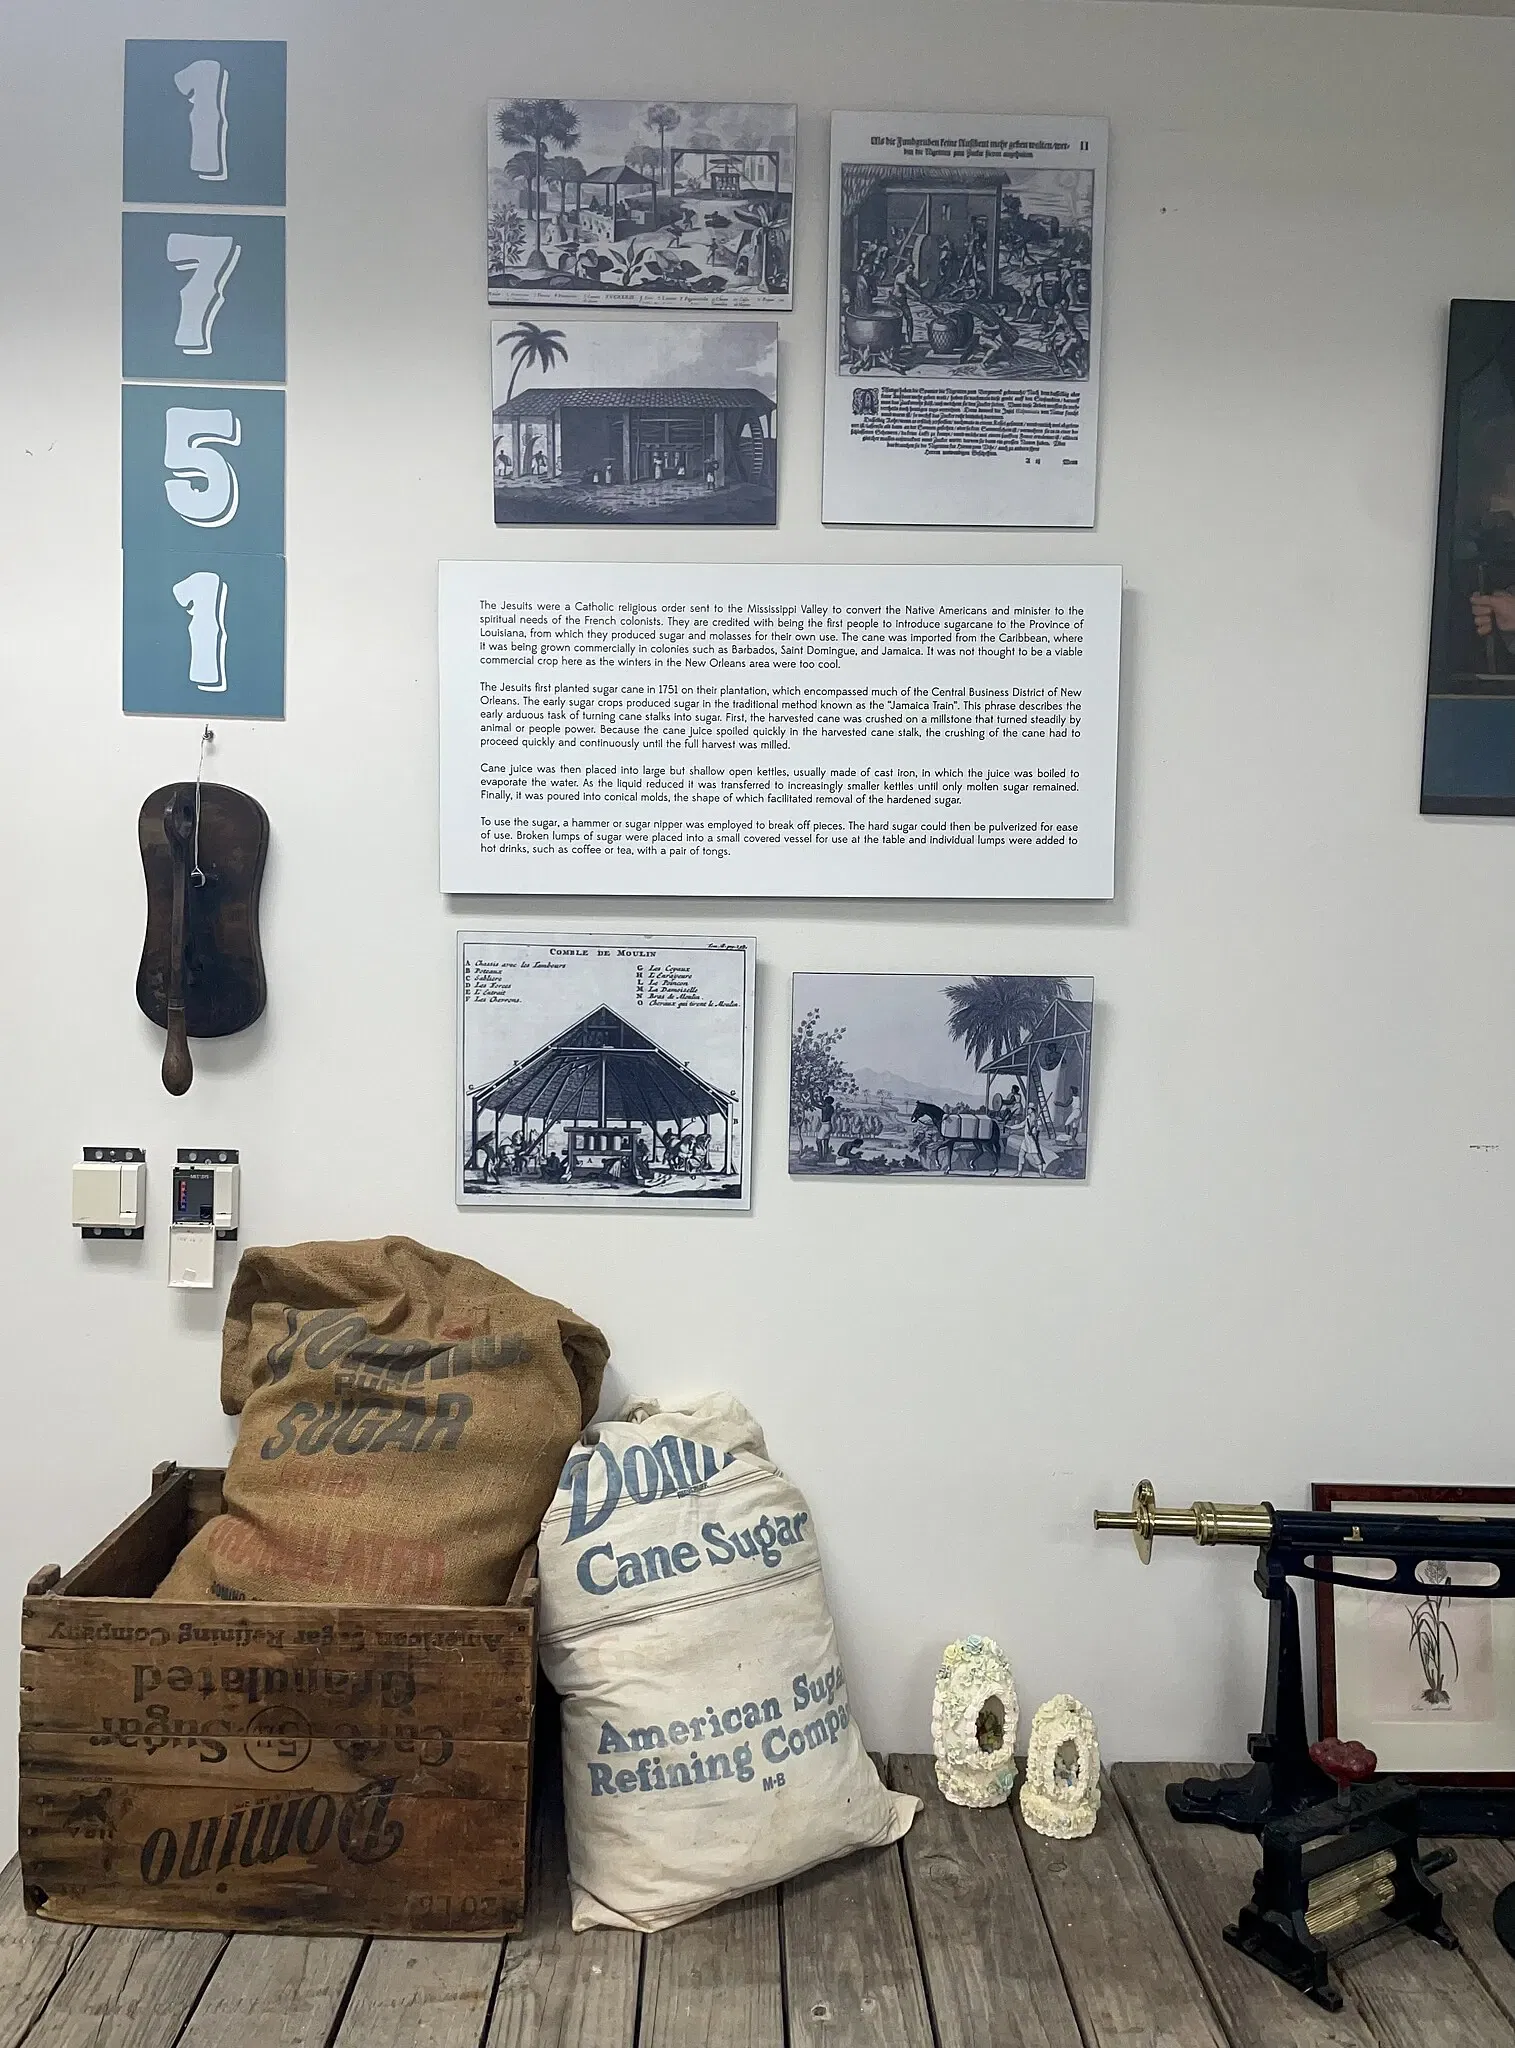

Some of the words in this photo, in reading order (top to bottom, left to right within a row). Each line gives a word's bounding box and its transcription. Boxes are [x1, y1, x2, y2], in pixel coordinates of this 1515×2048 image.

[480, 600, 496, 610] The
[501, 601, 532, 610] Jesuits
[575, 601, 614, 612] Catholic
[618, 602, 657, 616] religious
[662, 602, 686, 613] order
[690, 604, 709, 613] sent
[714, 604, 723, 613] to
[728, 604, 743, 613] the
[747, 604, 796, 616] Mississippi
[801, 604, 828, 617] Valley
[832, 605, 842, 614] to
[846, 606, 881, 615] convert
[886, 605, 901, 614] the
[906, 605, 935, 615] Native
[939, 606, 987, 615] Americans
[992, 605, 1010, 615] and
[1014, 607, 1050, 615] minister
[1055, 606, 1064, 615] to
[1069, 606, 1084, 615] the
[480, 654, 534, 665] commercial
[538, 658, 558, 668] crop
[562, 656, 582, 666] here
[600, 656, 614, 666] the
[618, 657, 652, 667] winters
[655, 658, 663, 666] in
[666, 657, 682, 667] the
[685, 658, 706, 668] New
[710, 658, 746, 668] Orleans
[800, 660, 815, 669] too
[818, 659, 840, 669] cool.
[480, 681, 497, 692] The
[500, 682, 532, 692] Jesuits
[535, 682, 551, 693] first
[554, 682, 589, 695] planted
[592, 686, 618, 697] sugar
[621, 686, 644, 694] cane
[647, 685, 656, 694] in
[659, 684, 678, 694] 1751
[696, 685, 717, 695] their
[720, 685, 769, 698] plantation,
[772, 685, 800, 696] which
[804, 686, 868, 698] encompassed
[872, 686, 898, 696] much
[900, 686, 911, 697] of
[914, 686, 928, 696] the
[932, 687, 966, 697] Central
[969, 687, 1009, 697] Business
[1012, 687, 1044, 697] District
[1048, 686, 1058, 697] of
[1061, 688, 1082, 697] New
[481, 789, 513, 802] Finally,
[516, 791, 522, 799] it
[547, 790, 580, 803] poured
[583, 792, 601, 801] into
[604, 791, 638, 802] conical
[641, 792, 670, 802] molds,
[674, 792, 688, 802] the
[692, 792, 720, 805] shape
[723, 792, 734, 803] of
[736, 793, 764, 803] which
[768, 793, 812, 804] facilitated
[816, 794, 852, 804] removal
[856, 793, 866, 804] of
[868, 794, 884, 804] the
[887, 794, 931, 804] hardened
[934, 797, 961, 808] sugar.
[481, 843, 496, 853] hot
[500, 843, 529, 854] drinks,
[532, 844, 554, 854] such
[572, 844, 601, 854] coffee
[617, 846, 634, 855] tea,
[637, 845, 657, 854] with
[670, 847, 686, 858] pair
[690, 845, 700, 855] of
[702, 847, 730, 859] tongs.
[617, 950, 657, 958] MOULIN
[261, 1393, 473, 1461] SUGAR
[576, 1541, 702, 1596] Cane
[701, 1511, 808, 1568] Sugar
[48, 1621, 171, 1646] Company
[131, 1664, 416, 1707] Granulated
[89, 1704, 232, 1763] Sugar
[597, 1696, 783, 1755] American
[587, 1740, 756, 1796] Refining
[140, 1776, 404, 1893] Domino
